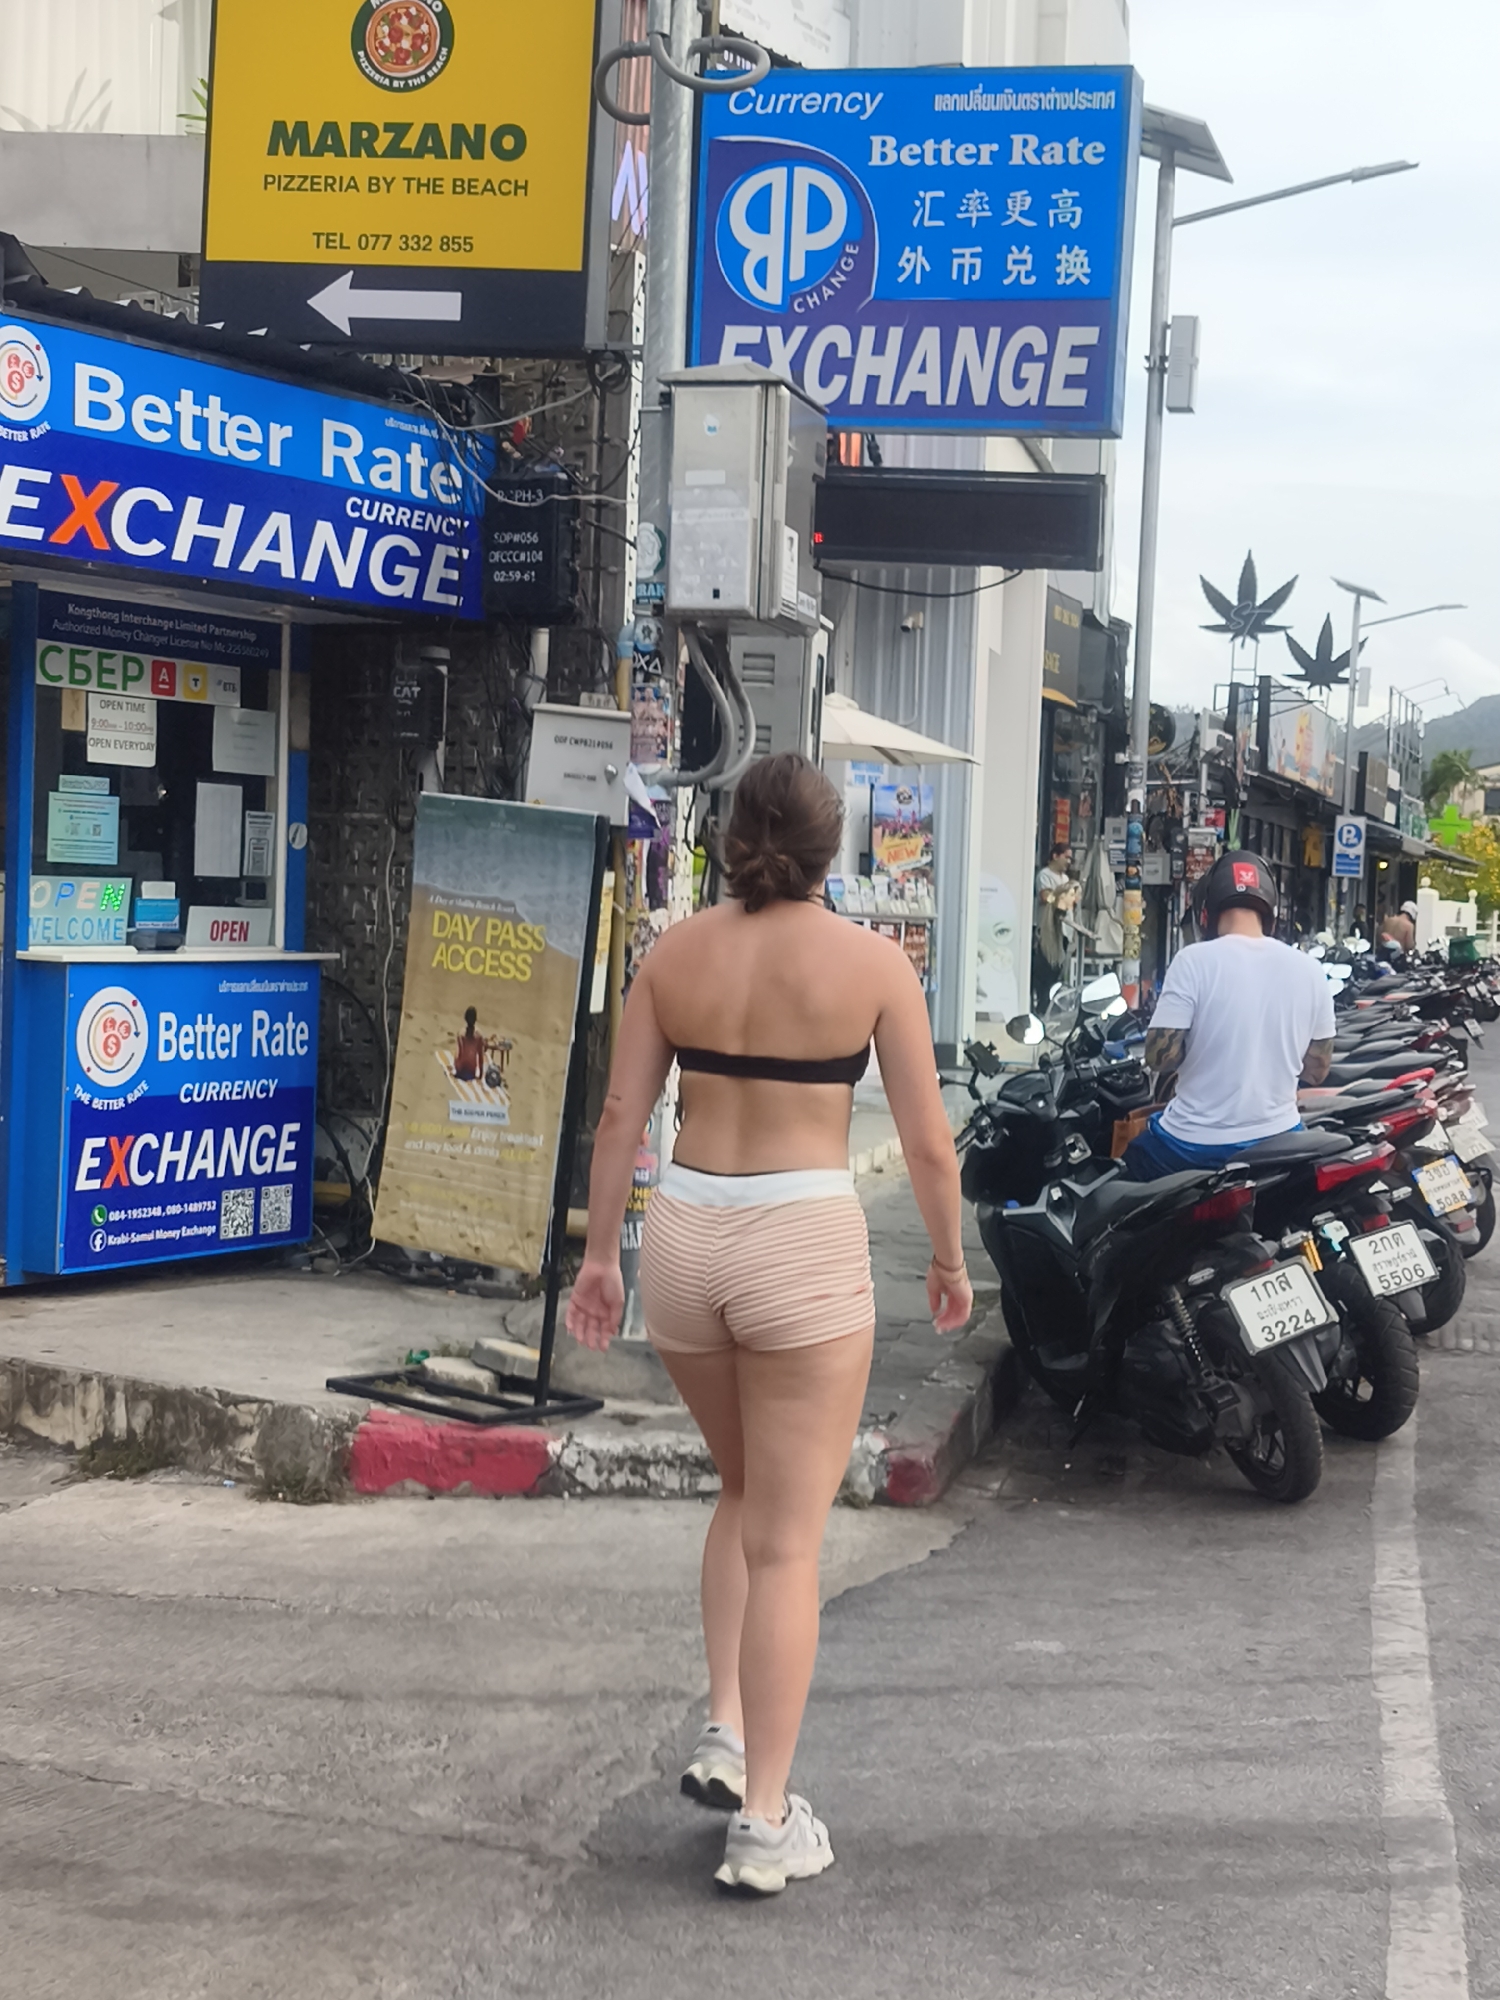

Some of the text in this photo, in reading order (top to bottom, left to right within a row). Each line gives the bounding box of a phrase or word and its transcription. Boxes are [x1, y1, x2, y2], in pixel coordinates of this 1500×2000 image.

[358, 47, 448, 88] PIZZERIA BY THE BEACH
[728, 86, 884, 120] Currency
[267, 120, 527, 162] MARZANO
[868, 134, 1106, 166] Better Rate
[263, 174, 529, 197] PIZZERIA BY THE BEACH
[912, 189, 1083, 229] 汇率更高
[312, 232, 474, 253] TEL 077 332 855
[793, 243, 860, 314] CHANGE
[897, 244, 1091, 286] 外币兑换
[73, 362, 464, 505] Better Rate
[346, 496, 470, 538] CURRENCY
[0, 464, 469, 607] EXCHANGE
[52, 619, 100, 636] Authorized
[68, 603, 120, 625] Kongthong
[121, 611, 174, 630] Interchange
[175, 619, 208, 634] Limited
[39, 645, 145, 691] СБЕР
[100, 700, 146, 713] OPEN TIME
[88, 737, 155, 751] OPEN EVERYDAY
[887, 844, 919, 864] NEW
[30, 880, 126, 912] OPEN
[210, 920, 250, 943] OPEN
[432, 910, 547, 952] DAY PASS
[431, 942, 533, 982] ACCESS
[158, 1010, 309, 1062] Better Rate
[74, 1080, 149, 1111] THE BETTER RATE
[179, 1078, 279, 1103] CURRENCY
[75, 1122, 301, 1191] EXCHANGE
[1378, 1263, 1426, 1291] 5506
[1261, 1308, 1318, 1343] 3224
